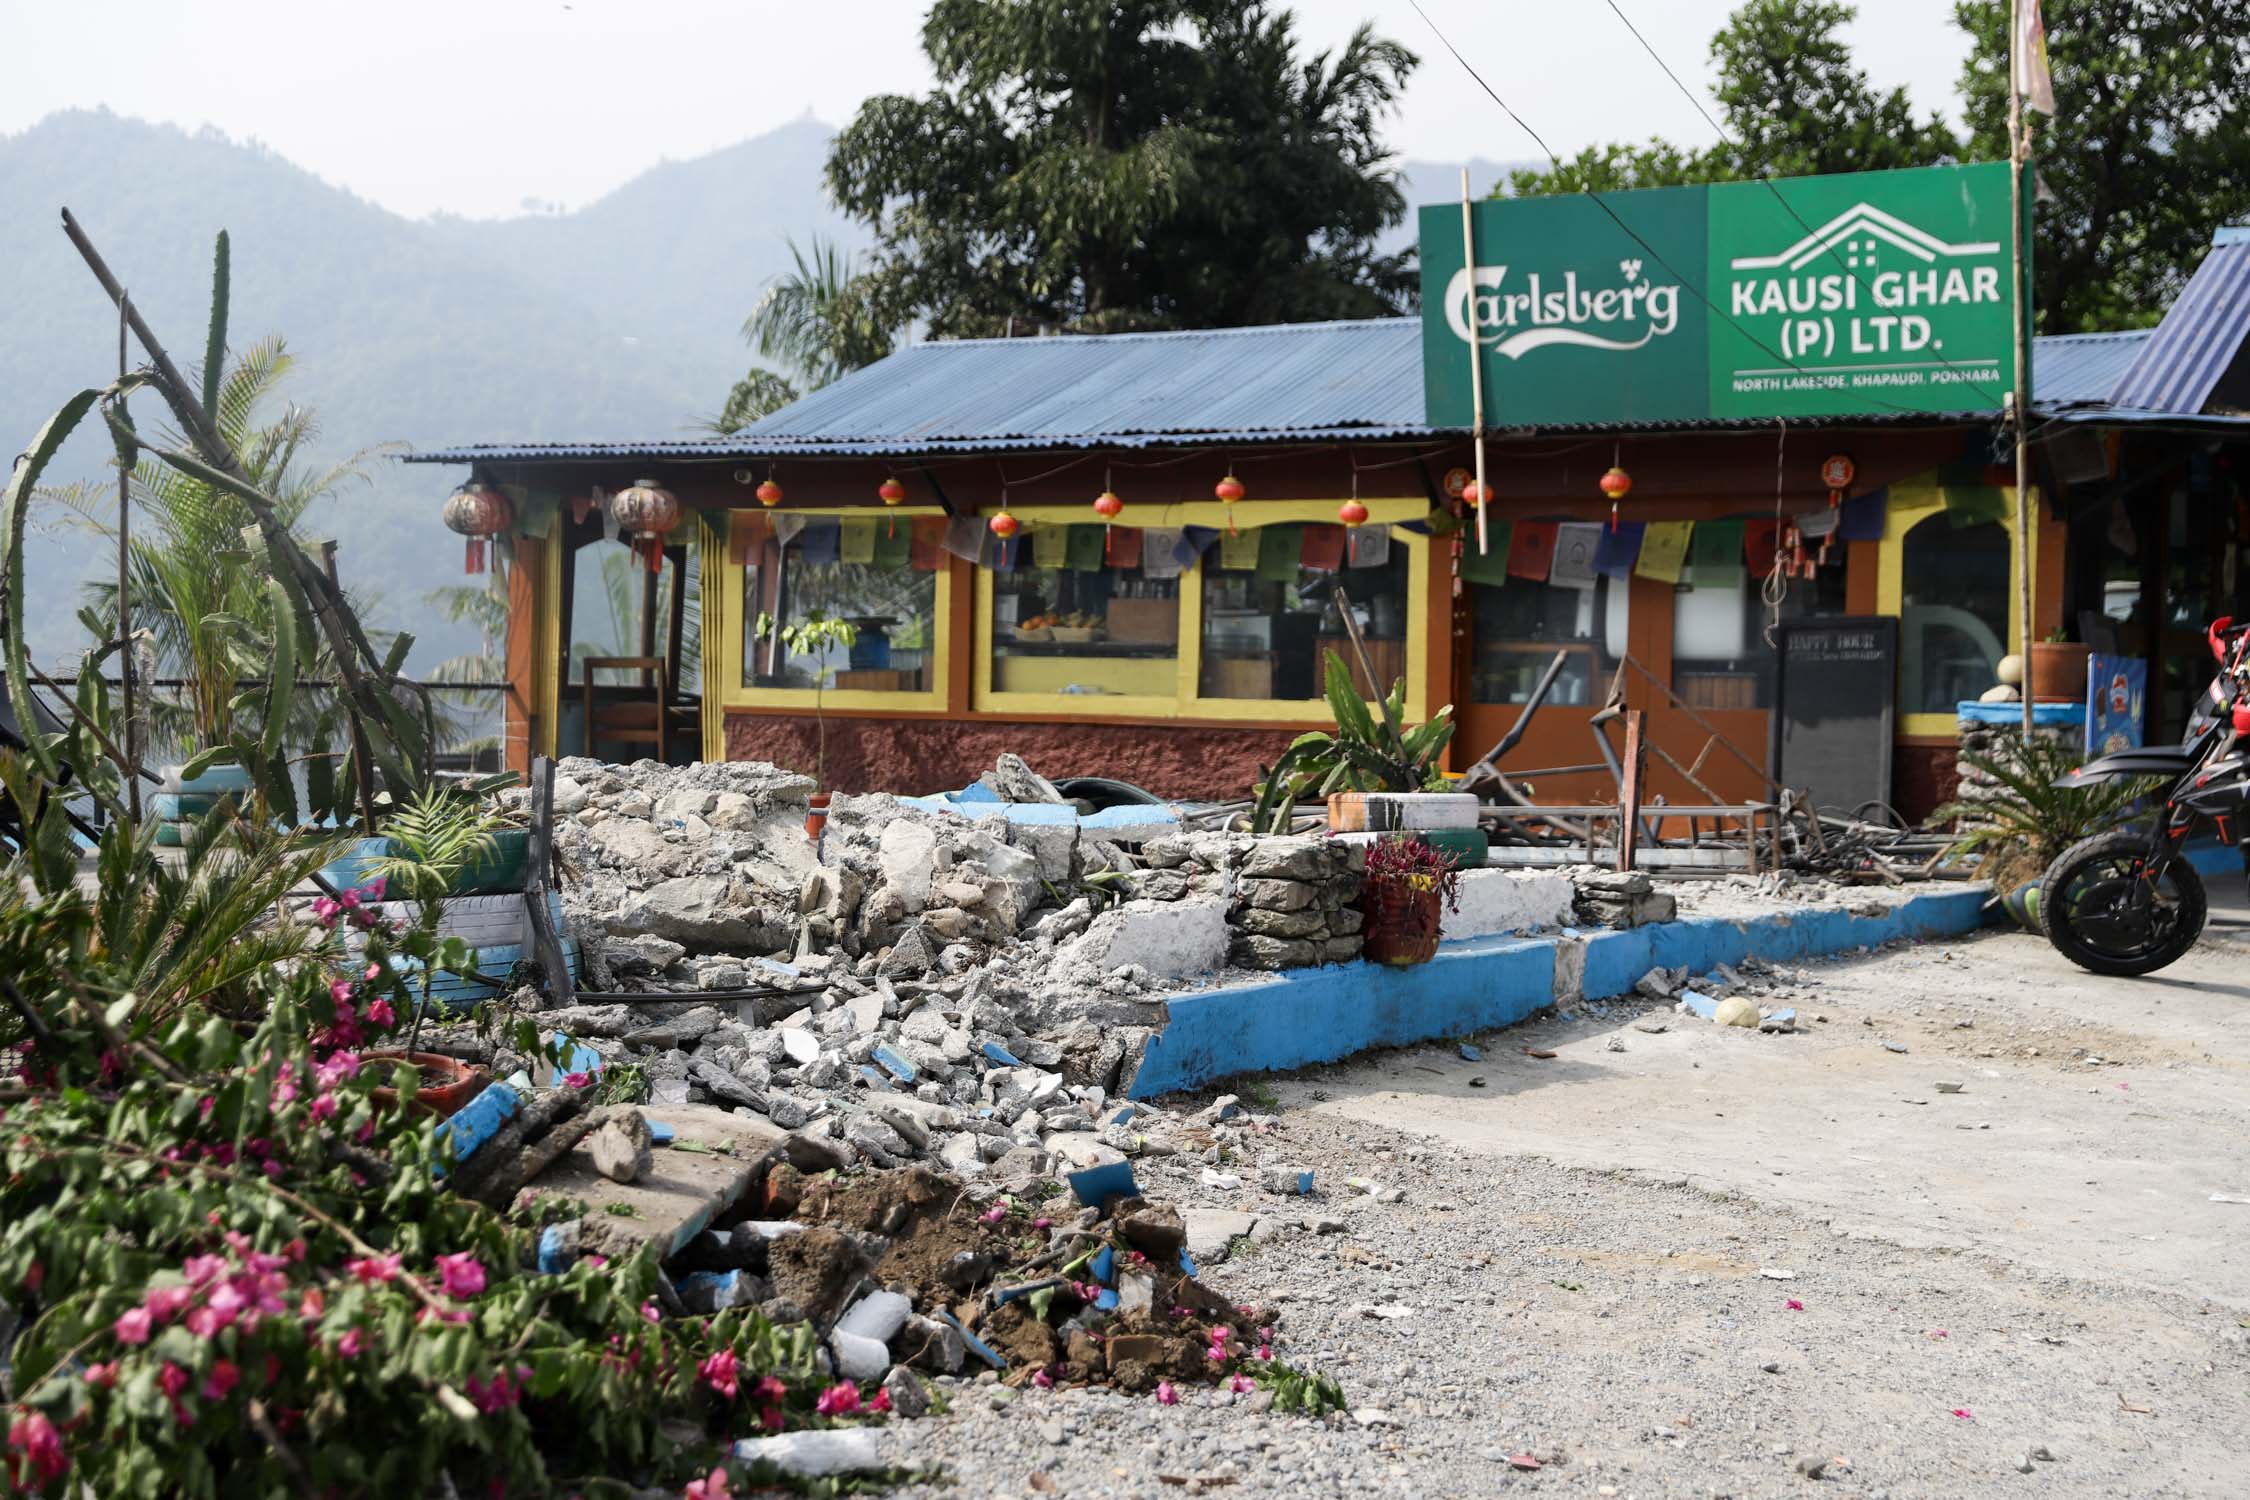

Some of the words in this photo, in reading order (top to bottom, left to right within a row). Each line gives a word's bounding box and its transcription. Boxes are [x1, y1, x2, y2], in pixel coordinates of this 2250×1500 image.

[1444, 264, 1681, 357] Carlsberg
[1731, 274, 1857, 317] KAUSI
[1871, 266, 2000, 309] GHAR
[1780, 316, 1836, 360] (P)
[1850, 315, 1943, 354] LTD.
[1732, 378, 1781, 393] NORTH
[1930, 369, 2000, 384] POKHARA
